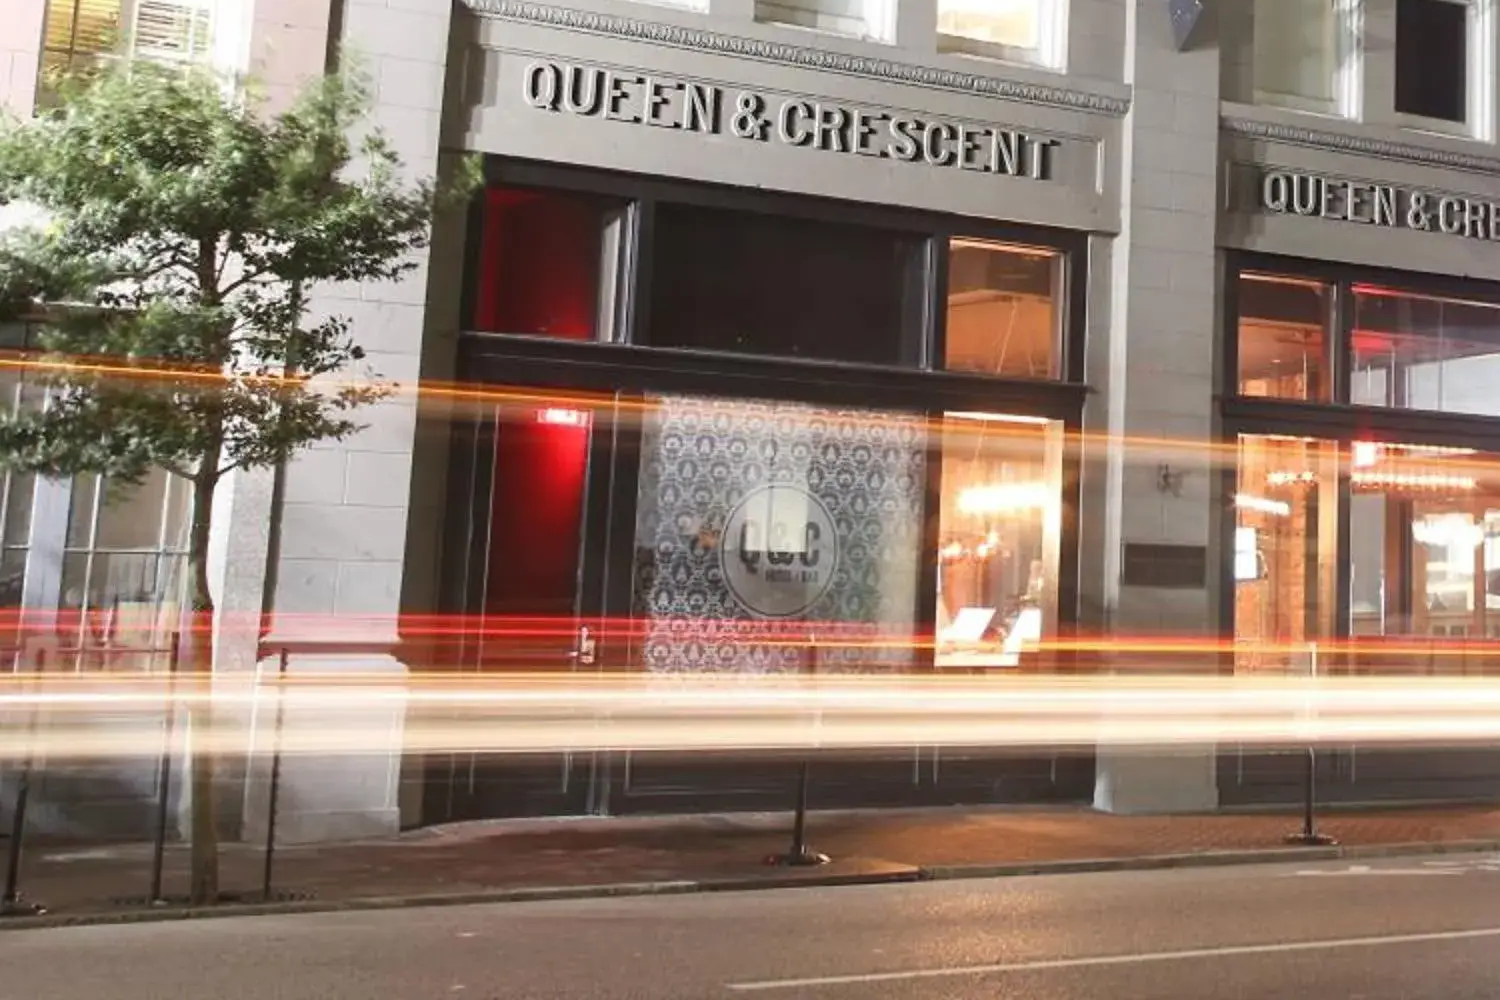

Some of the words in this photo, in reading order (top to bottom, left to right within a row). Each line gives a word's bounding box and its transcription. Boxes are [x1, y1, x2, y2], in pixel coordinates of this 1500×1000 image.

[522, 63, 722, 135] QUEEN
[730, 92, 768, 141] &
[777, 100, 1060, 181] CRESCENT
[1262, 172, 1397, 228] QUEEN
[1407, 189, 1432, 232] &
